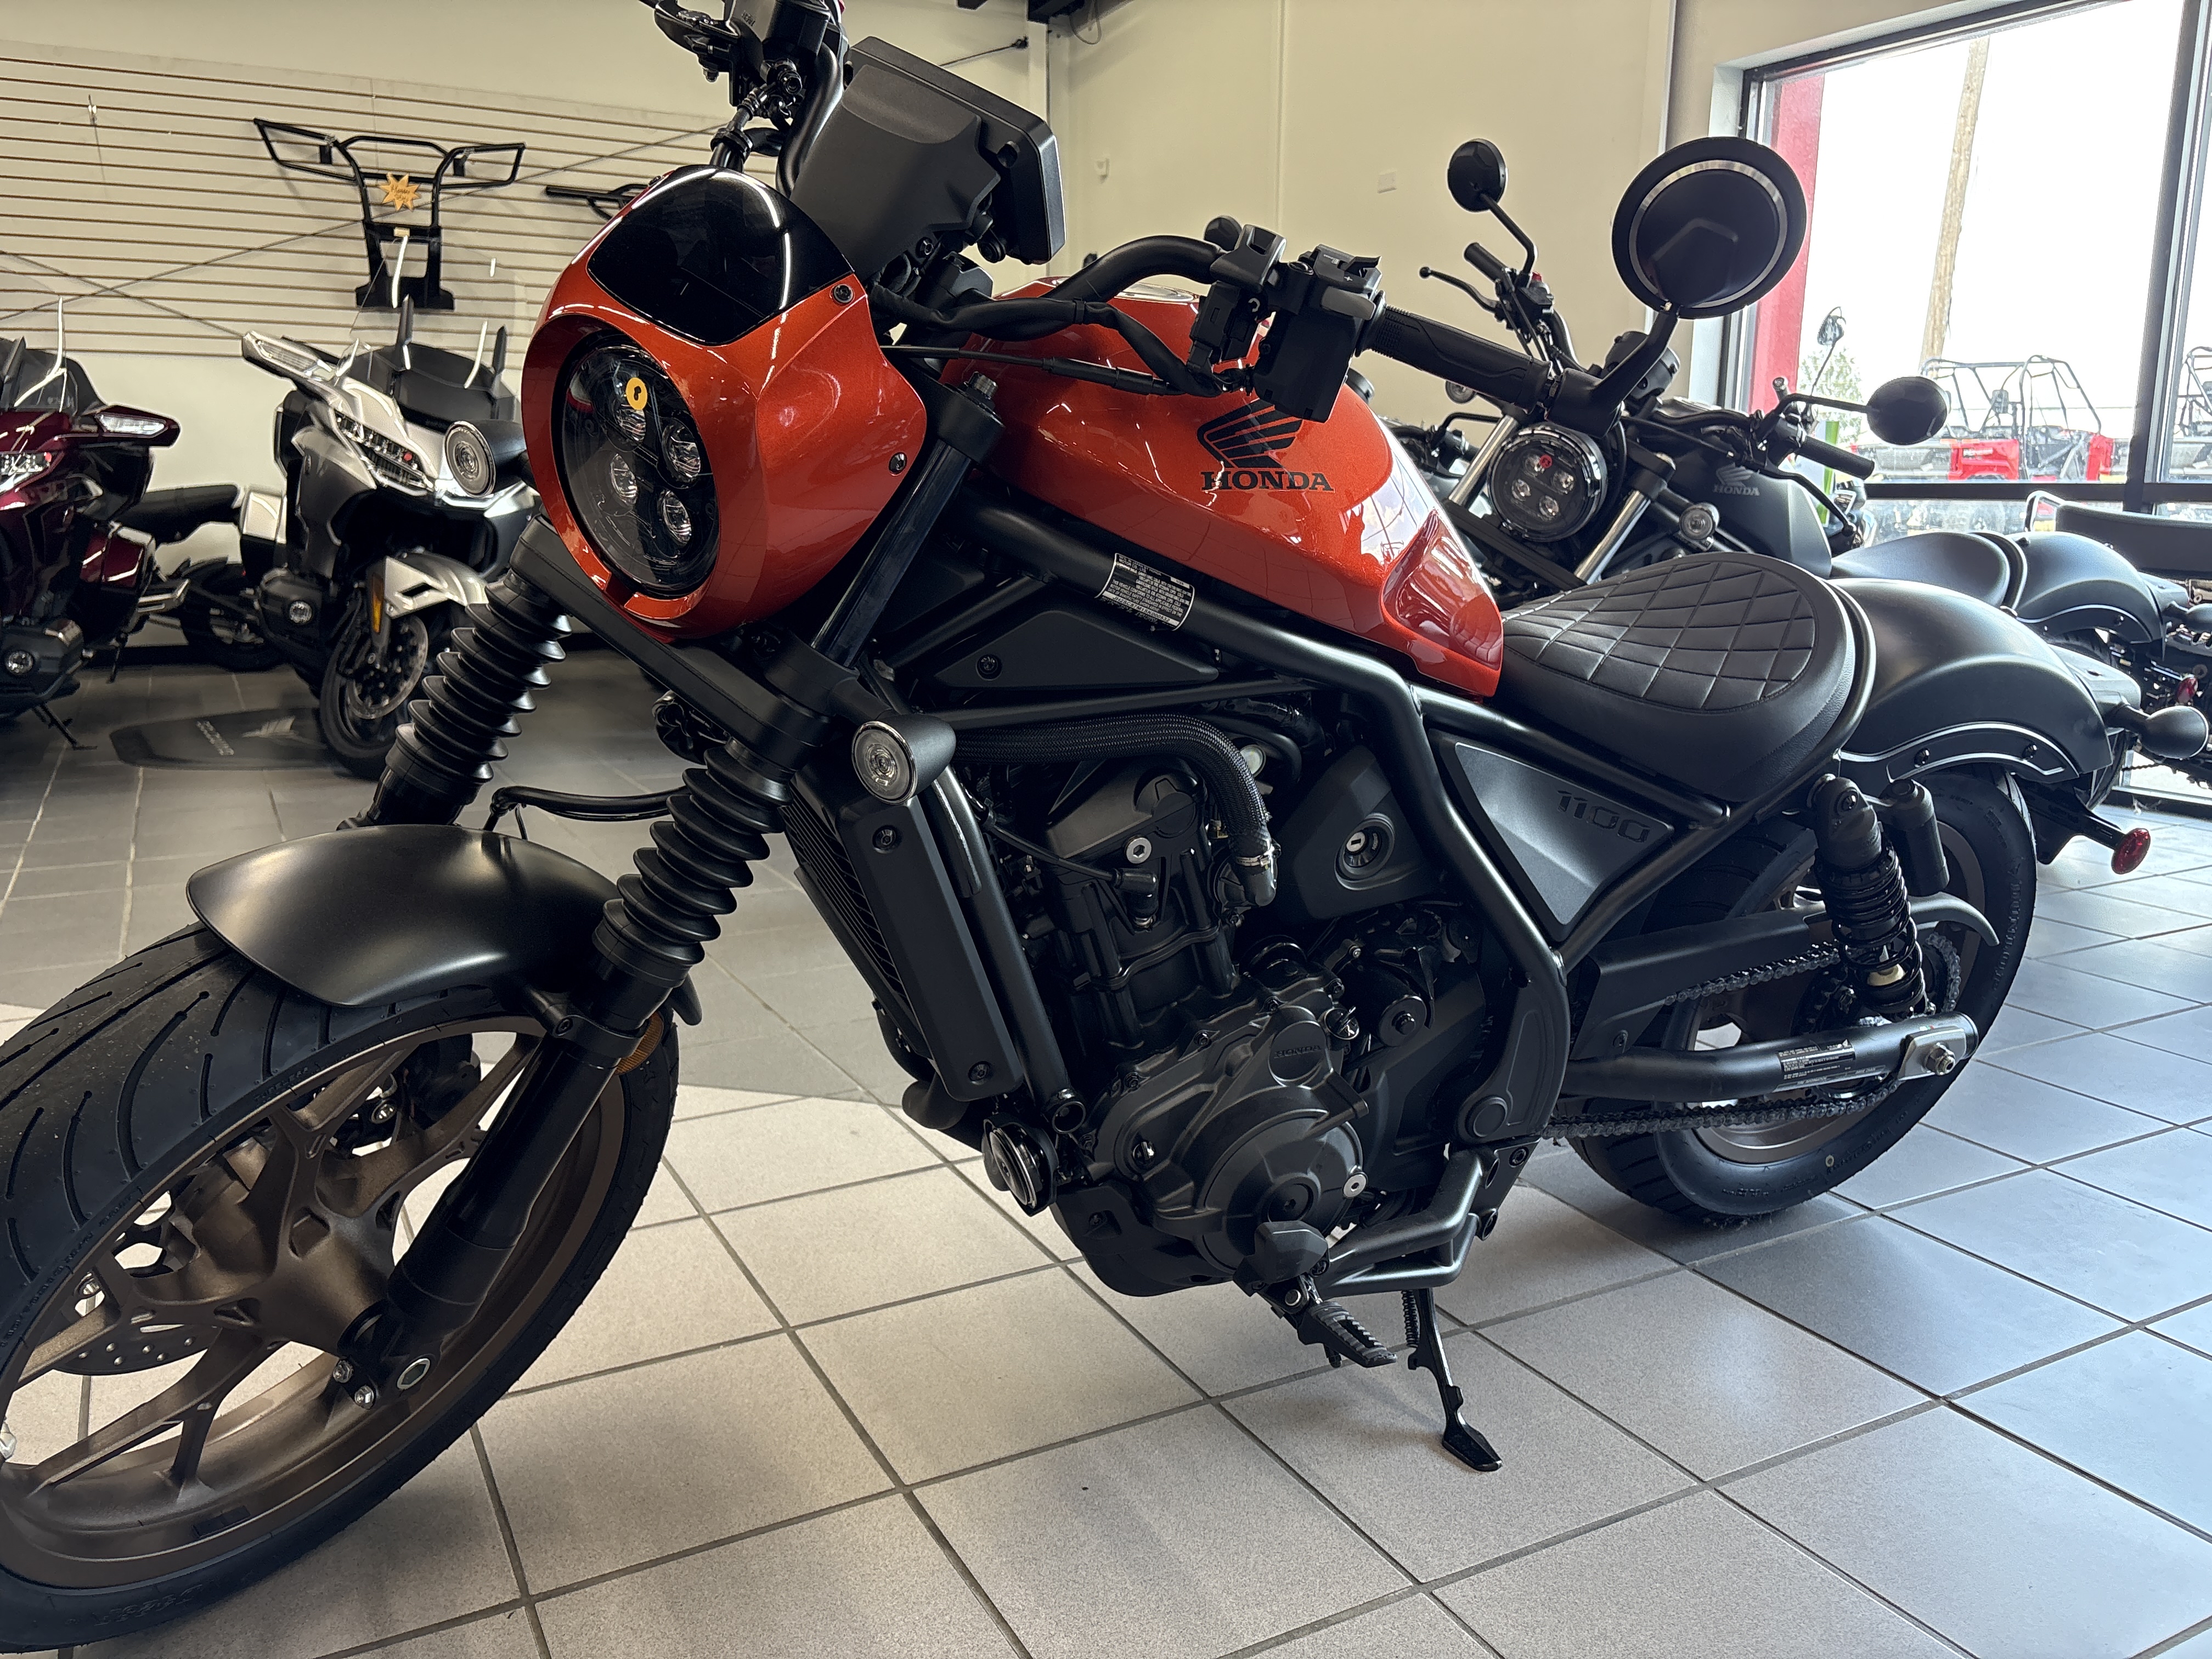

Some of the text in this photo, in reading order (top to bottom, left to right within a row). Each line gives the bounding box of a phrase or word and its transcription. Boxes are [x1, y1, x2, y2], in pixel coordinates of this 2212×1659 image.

[1201, 471, 1335, 492] HONDA
[1712, 484, 1760, 496] HONDA
[1557, 789, 1651, 843] 1100
[1274, 1045, 1322, 1058] HONDA
